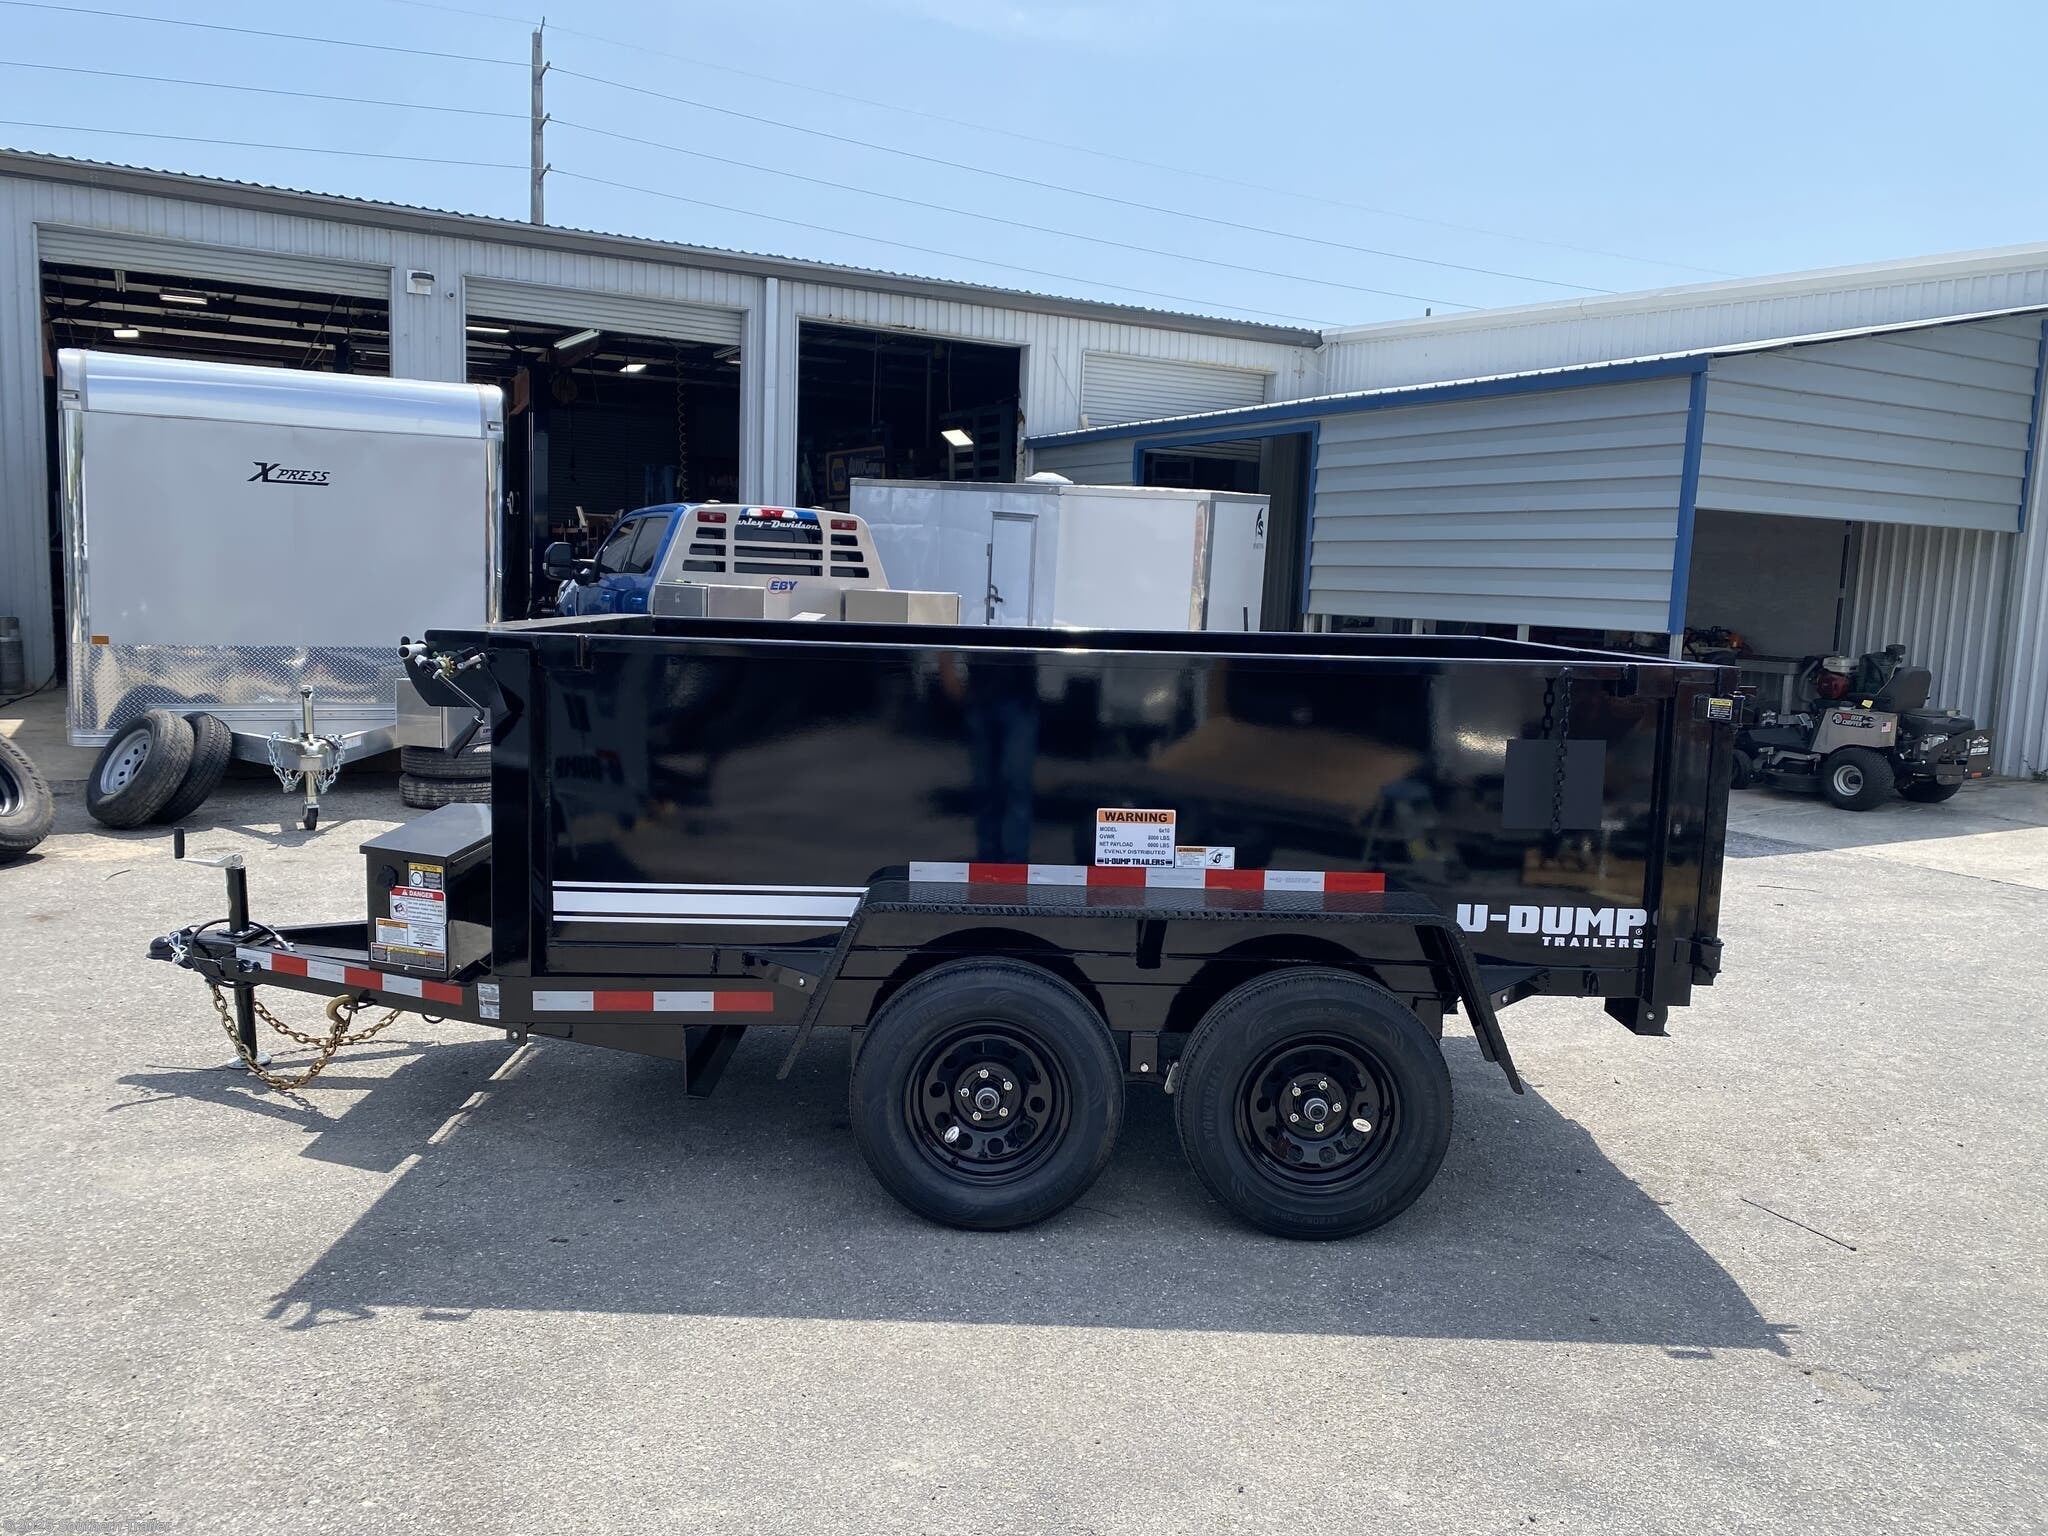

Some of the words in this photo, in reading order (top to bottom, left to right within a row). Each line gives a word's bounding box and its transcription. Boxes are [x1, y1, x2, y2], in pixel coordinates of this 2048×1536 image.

[247, 461, 331, 485] XPRESS
[770, 581, 798, 591] EBY
[1105, 811, 1168, 823] WARNING
[409, 890, 434, 898] DANGER
[1457, 904, 1648, 937] U-DUMP
[1542, 936, 1645, 949] TRAILERS
